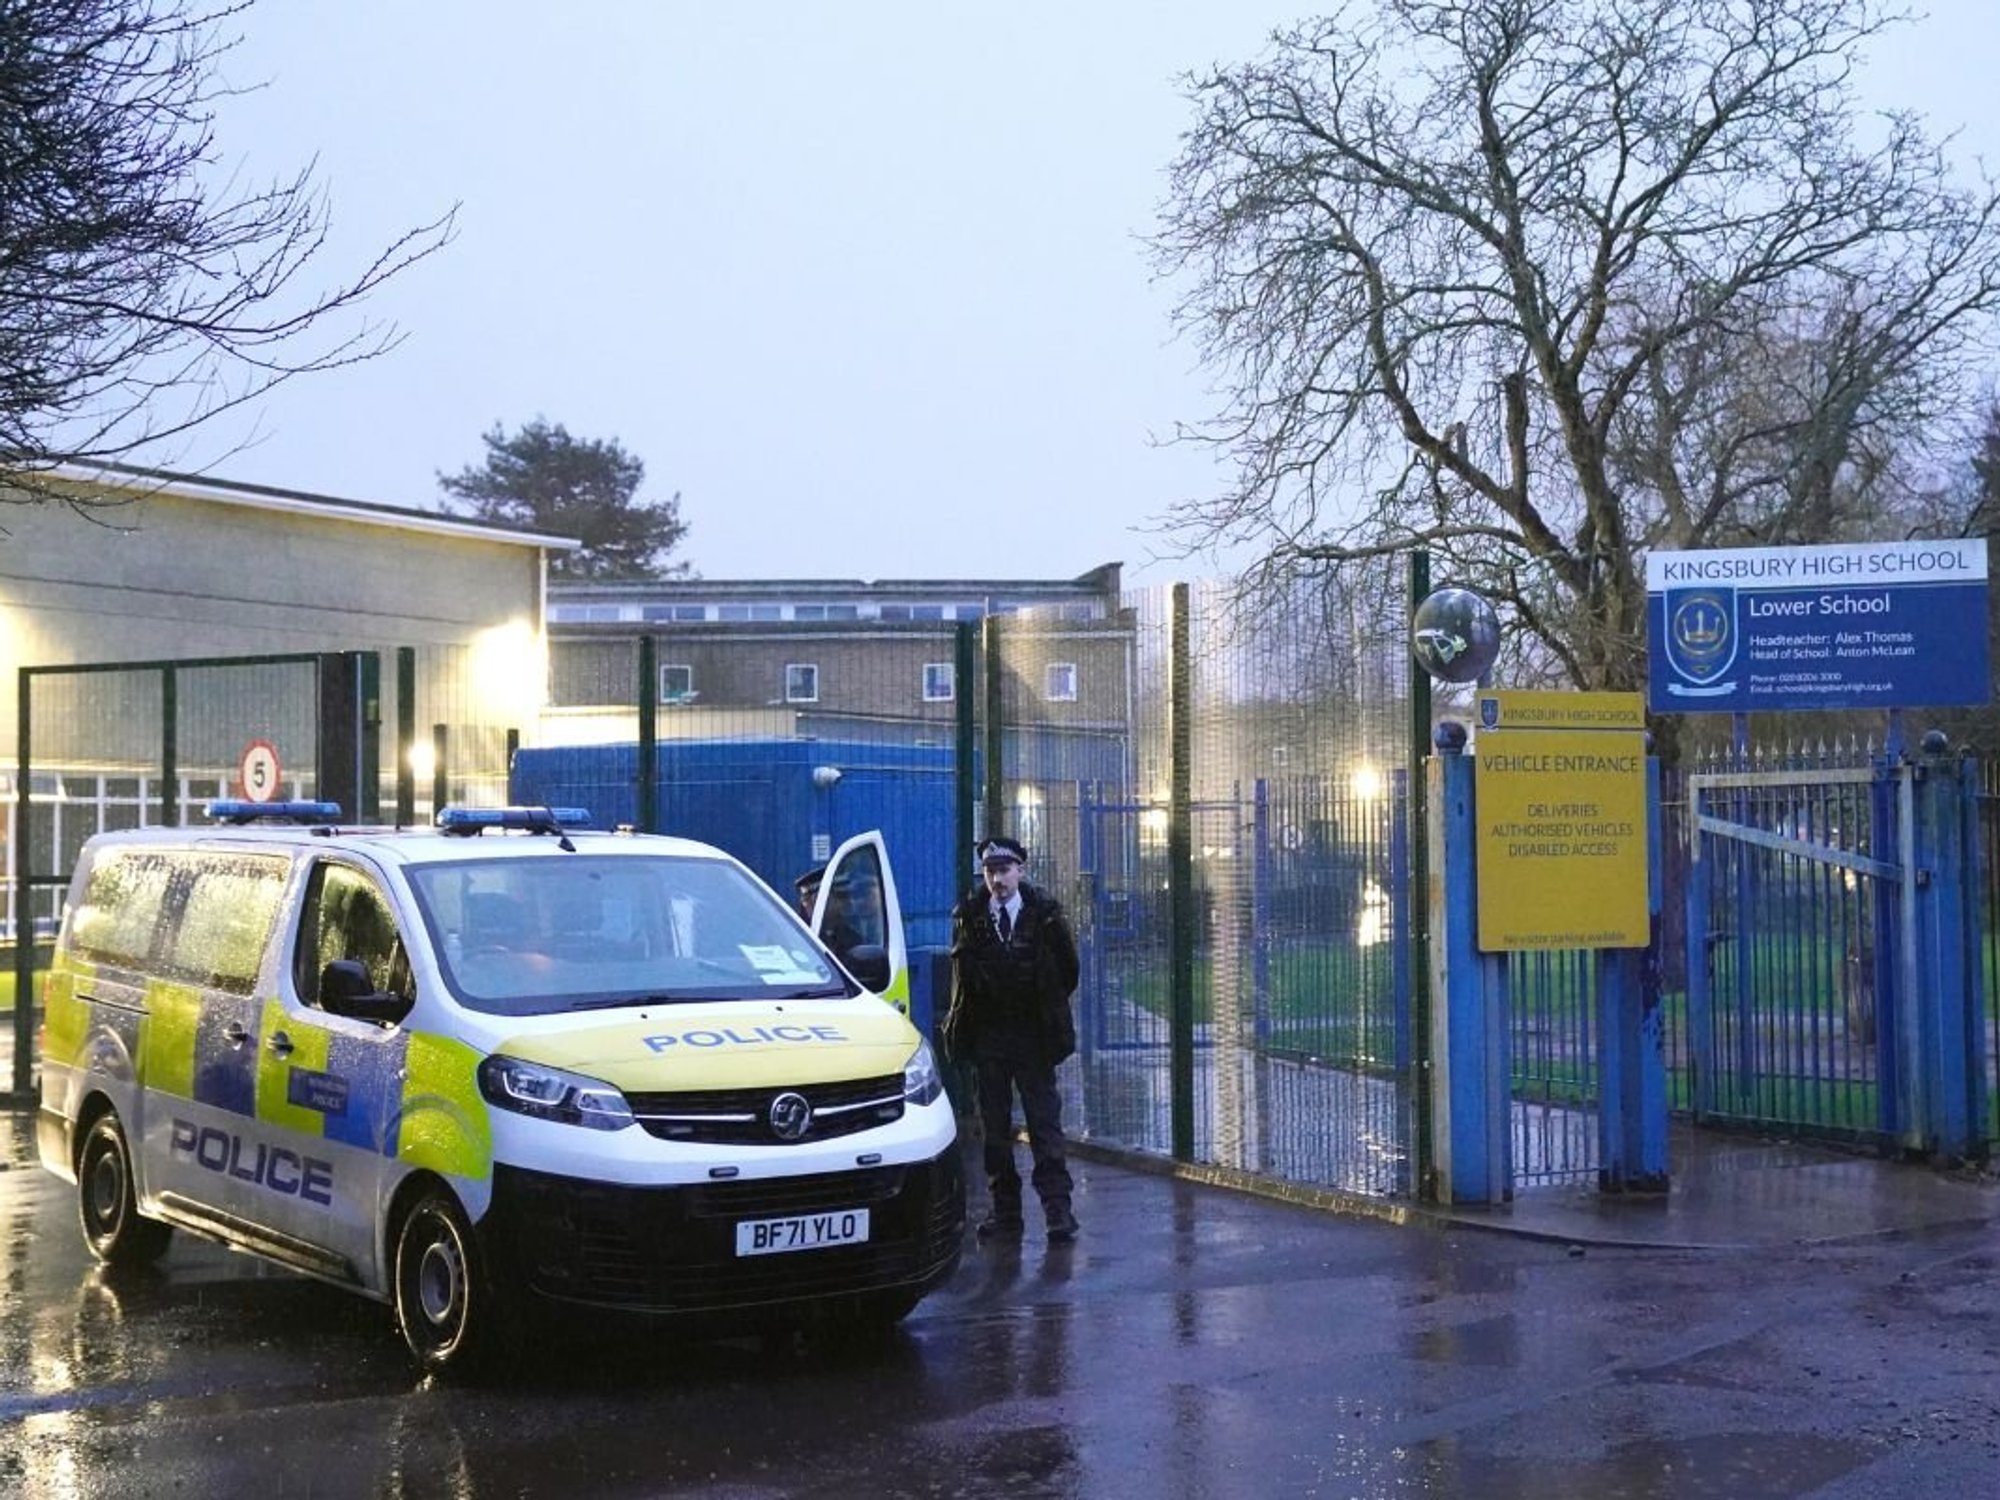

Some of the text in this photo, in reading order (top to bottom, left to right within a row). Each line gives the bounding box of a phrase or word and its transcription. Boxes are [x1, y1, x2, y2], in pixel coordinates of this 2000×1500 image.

[1664, 550, 1970, 581] KINGSBURY HIGH SCHOOL
[1750, 592, 1890, 617] Lower School
[1750, 631, 1914, 647] Headteacher: Alex Thomas
[1750, 649, 1778, 660] Head
[1780, 648, 1791, 659] of
[1793, 648, 1831, 660] School:
[1871, 645, 1915, 657] McLean
[1503, 709, 1639, 722] KINGSBURY HIGH SCHOOL
[1483, 755, 1638, 773] VEHICLE ENTRANCE
[254, 761, 265, 788] 5
[1527, 804, 1598, 818] DELIVERIES
[1491, 823, 1634, 837] AUTHORISED VEHICLES
[1508, 842, 1619, 857] DISABLED ACCESS
[642, 1026, 849, 1053] POLICE
[172, 1117, 334, 1206] POLICE
[753, 1214, 855, 1248] BF71 YLO
